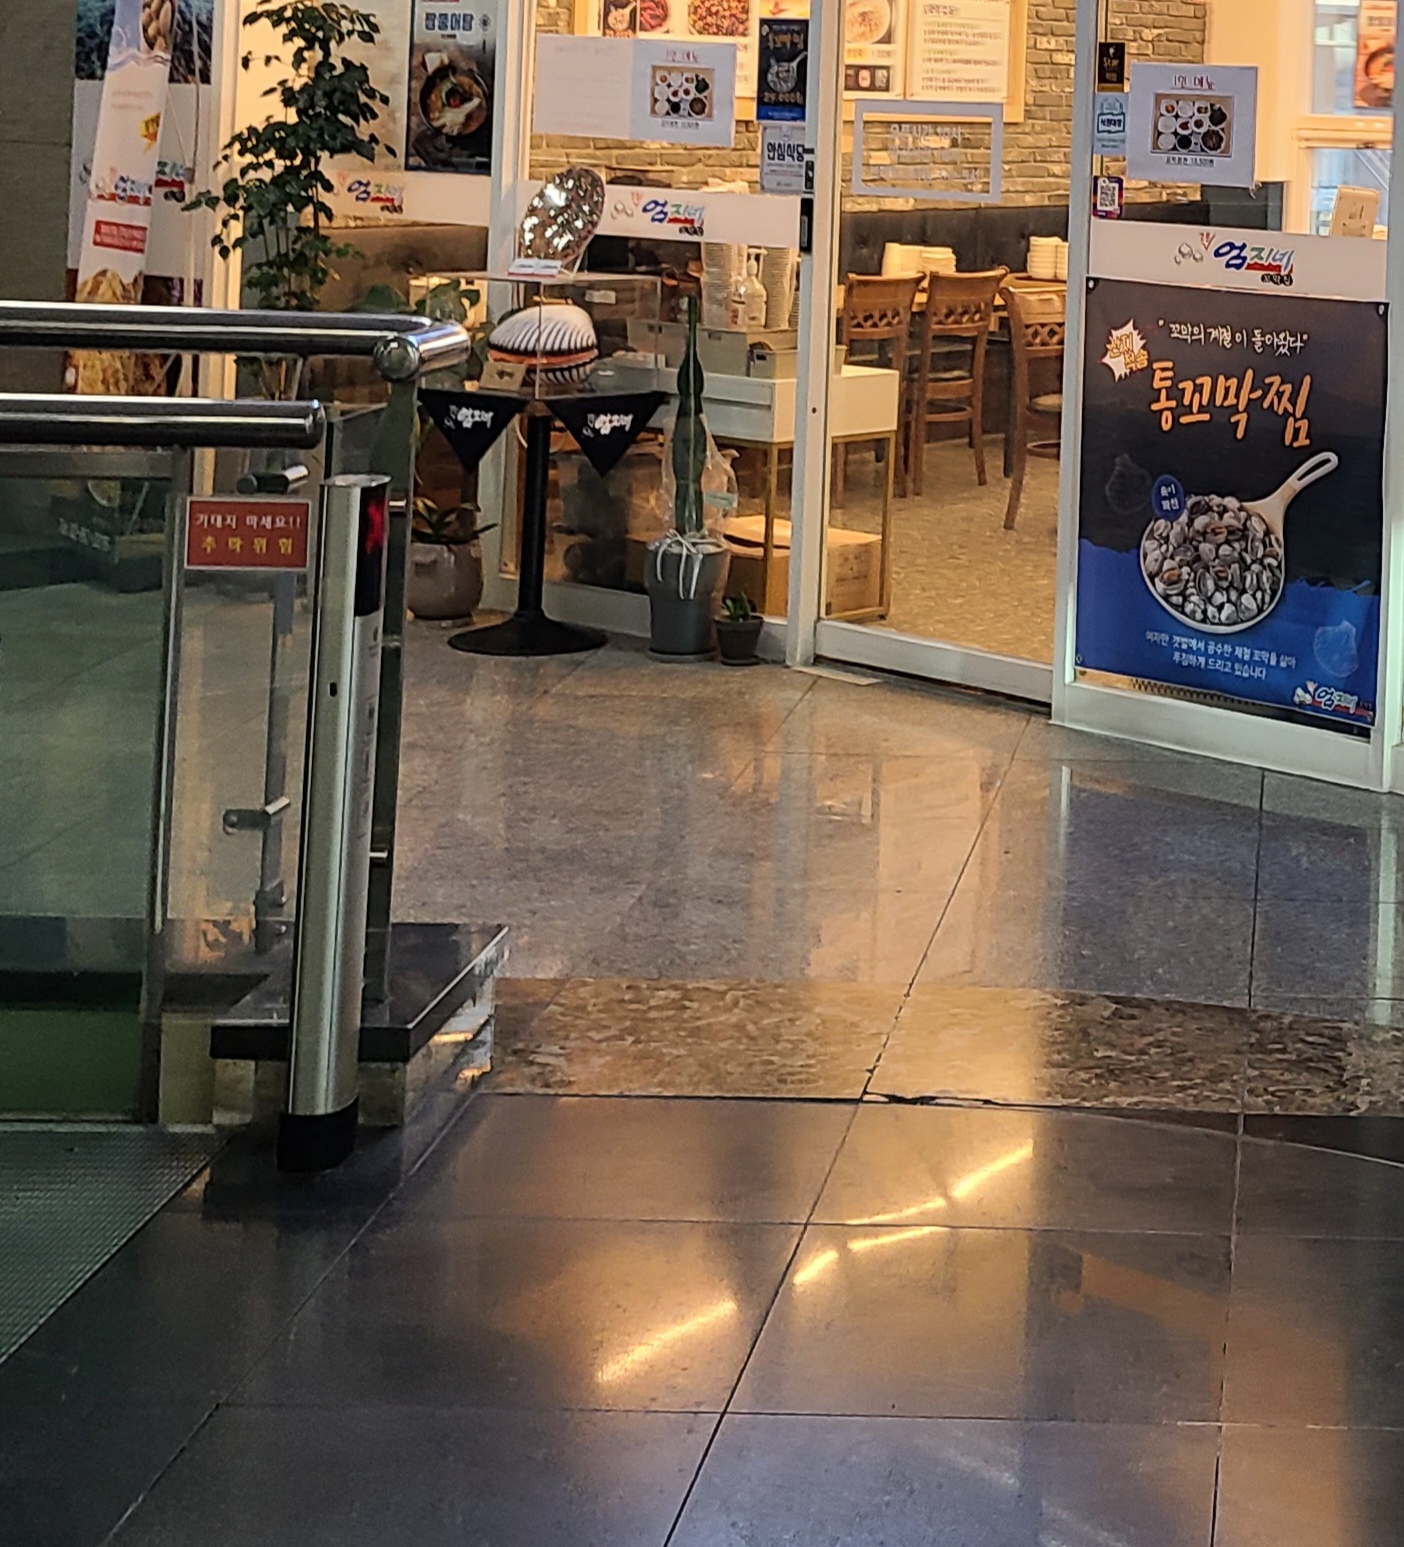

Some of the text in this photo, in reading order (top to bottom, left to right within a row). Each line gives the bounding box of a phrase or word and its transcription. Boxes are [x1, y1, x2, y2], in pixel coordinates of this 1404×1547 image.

[766, 141, 806, 164] 안심식당
[641, 199, 705, 224] 엄지네
[1213, 240, 1294, 272] 엄지네
[1150, 360, 1312, 449] 통꼬막찜
[196, 513, 301, 530] 기대지 마세요!!
[1207, 659, 1233, 673] 드리고
[1234, 662, 1267, 681] 있습니다
